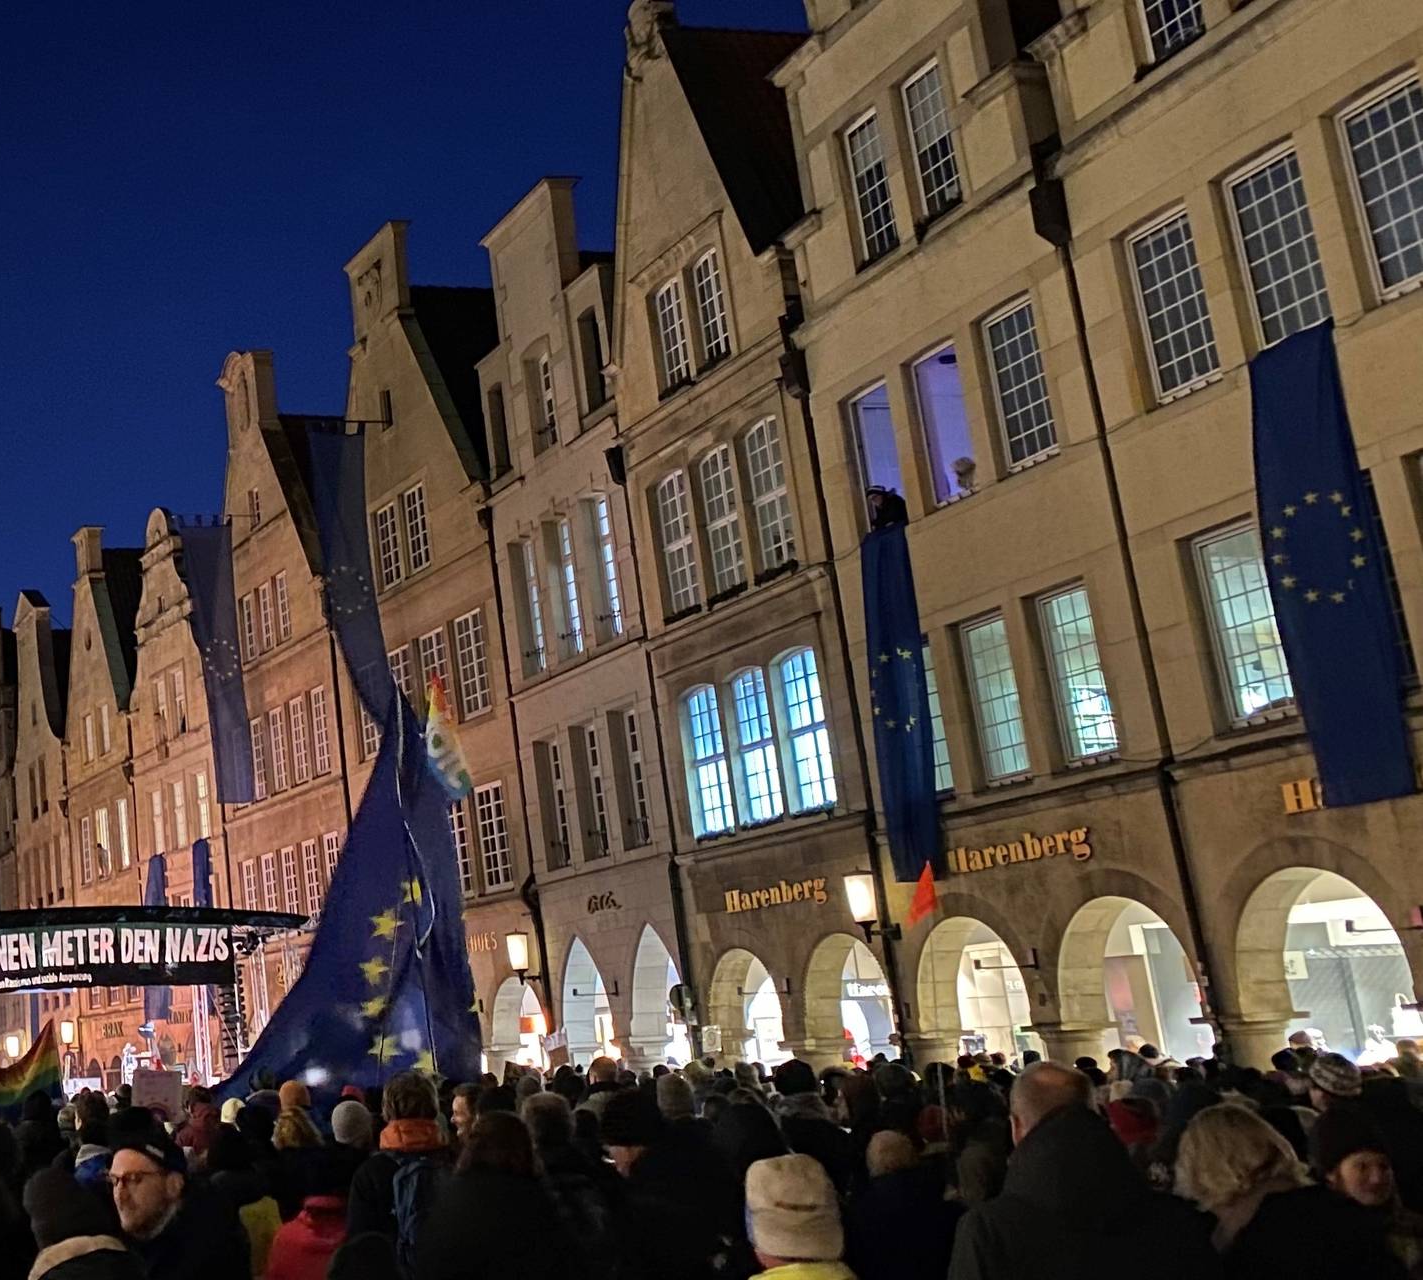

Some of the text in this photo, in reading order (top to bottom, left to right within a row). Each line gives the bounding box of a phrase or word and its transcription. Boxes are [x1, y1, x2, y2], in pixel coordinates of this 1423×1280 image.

[947, 826, 1092, 874] Harenberg
[724, 877, 828, 914] Harenberg
[42, 927, 115, 968] METER
[120, 928, 160, 964] DEN
[164, 927, 229, 965] NAZIS
[102, 1021, 124, 1039] BRAX
